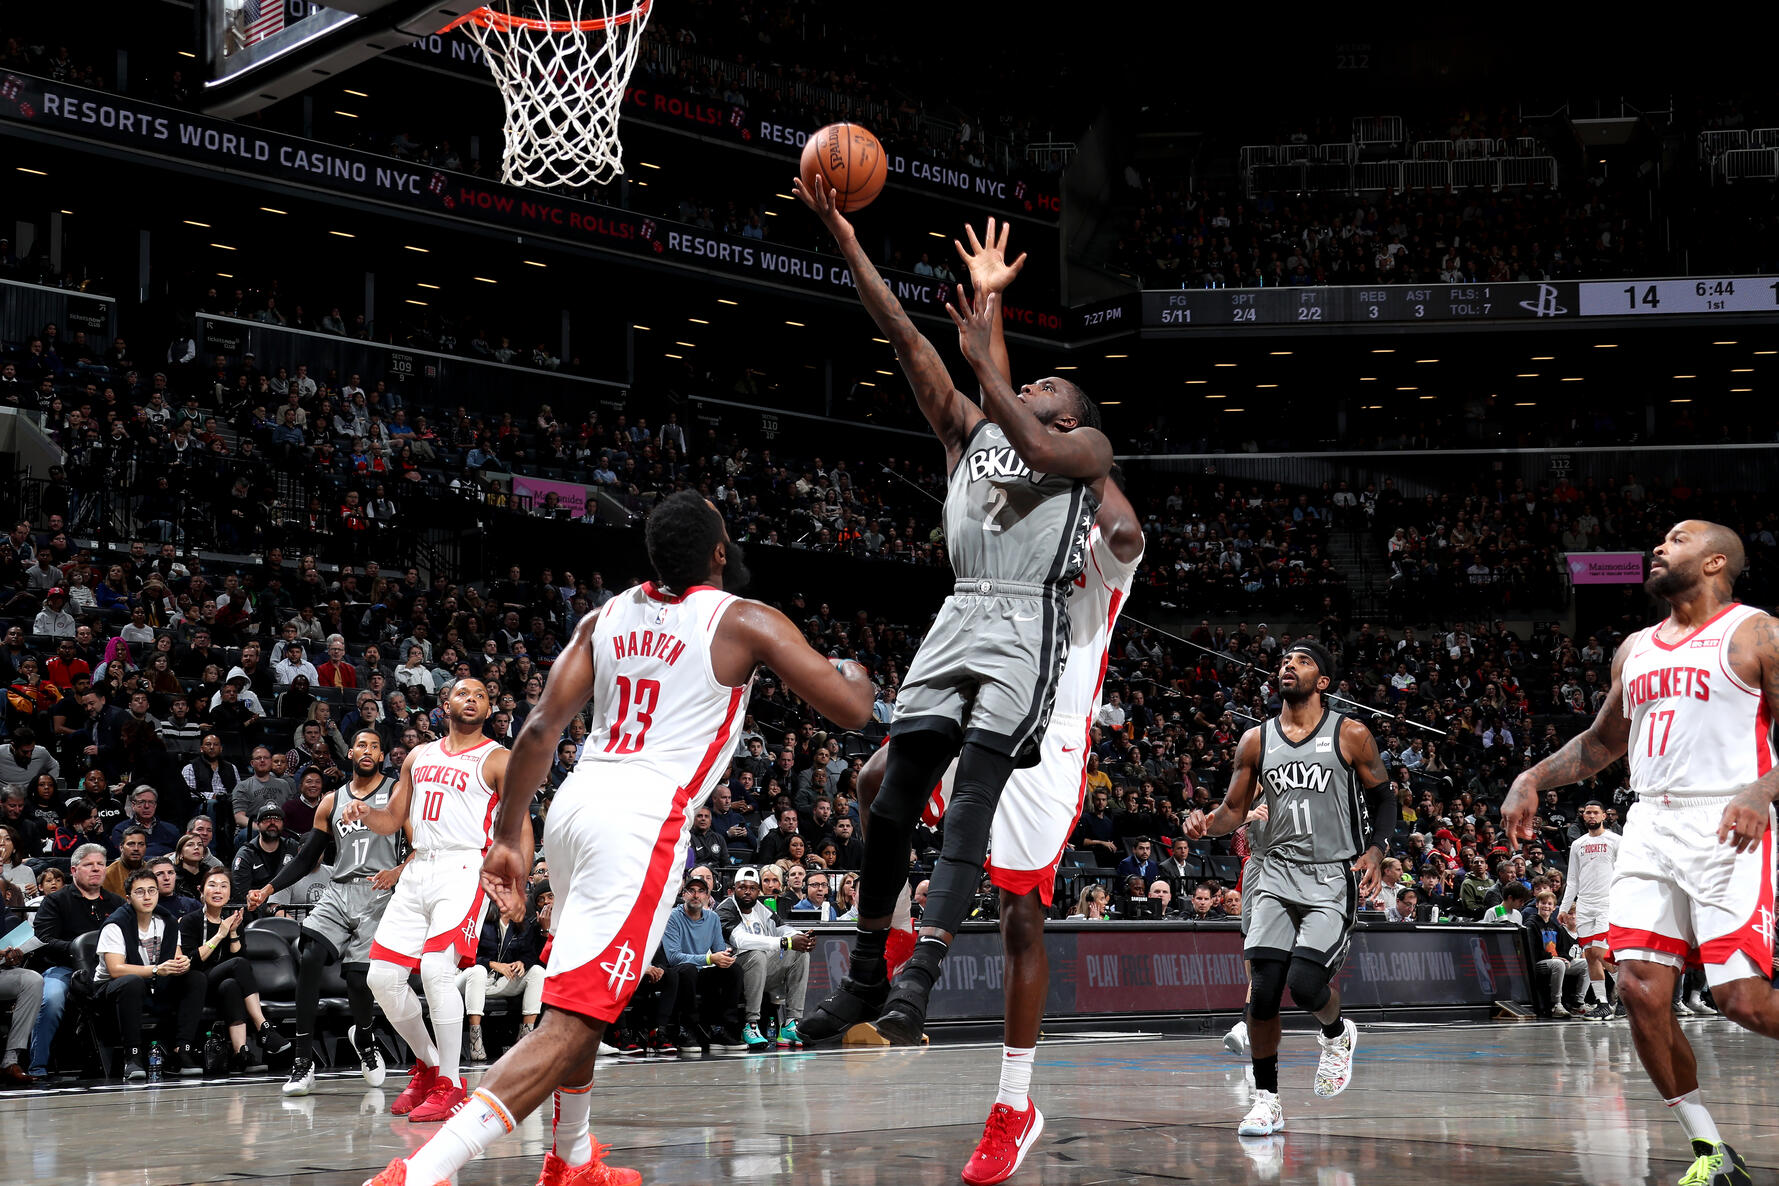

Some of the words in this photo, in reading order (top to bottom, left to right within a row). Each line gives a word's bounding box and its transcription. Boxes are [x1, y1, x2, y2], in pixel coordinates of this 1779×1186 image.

[624, 87, 649, 107] YC
[653, 93, 724, 127] ROLLS!
[44, 92, 169, 139] RESORTS
[179, 123, 269, 161] WORLD
[280, 147, 366, 182] CASINO
[376, 168, 421, 194] NYC
[760, 121, 812, 148] RESO
[911, 161, 969, 189] CASINO
[975, 177, 1006, 199] NYC
[1037, 193, 1060, 212] HO
[460, 188, 514, 213] HOW
[521, 202, 563, 224] NYC
[569, 212, 635, 239] ROLLS!
[668, 232, 754, 265] RESORTS
[761, 252, 823, 280] WORLD
[898, 281, 931, 303] NYC
[1301, 293, 1317, 303] FT
[1360, 291, 1387, 301] REB
[1406, 290, 1432, 301] AST
[1450, 289, 1479, 300] FLS:
[1484, 288, 1490, 298] 1
[1624, 285, 1660, 309] 14
[1695, 281, 1735, 296] 6:44
[1169, 296, 1187, 306] FG
[1232, 294, 1256, 305] 3PT
[1450, 304, 1480, 315] TOL:
[1483, 303, 1492, 314] 7
[1706, 300, 1725, 310] 1st
[1002, 305, 1034, 324] NYC
[1083, 312, 1104, 327] 7:27
[1106, 307, 1122, 320] PM
[1161, 309, 1191, 323] 5/11
[1233, 308, 1256, 322] 2/4
[1298, 307, 1322, 321] 2/2
[1369, 306, 1379, 318] 3
[1415, 304, 1425, 317] 3
[391, 360, 412, 372] 109
[761, 419, 778, 431] 110
[1551, 460, 1570, 469] 112
[982, 485, 1008, 532] 2
[1589, 562, 1640, 571] Maimonides
[613, 630, 686, 666] HARDEN
[1628, 666, 1710, 708] ROCKETS
[603, 675, 661, 754] 13
[1647, 709, 1675, 758] 17
[413, 764, 470, 792] ROCKETS
[1265, 761, 1334, 797] BKLYN
[97, 809, 120, 818] idas
[422, 790, 444, 821] 10
[1288, 798, 1313, 835] 11
[351, 837, 370, 866] 17
[1584, 843, 1608, 854] ROCKETS
[952, 955, 1006, 990] TIP-OF
[1086, 955, 1120, 987] PLAY
[1121, 955, 1152, 986] FREE
[1153, 954, 1180, 986] ONE
[1180, 954, 1205, 985] DAY
[1205, 953, 1249, 985] FANTA
[1359, 951, 1456, 982] NBA.COM/WIN
